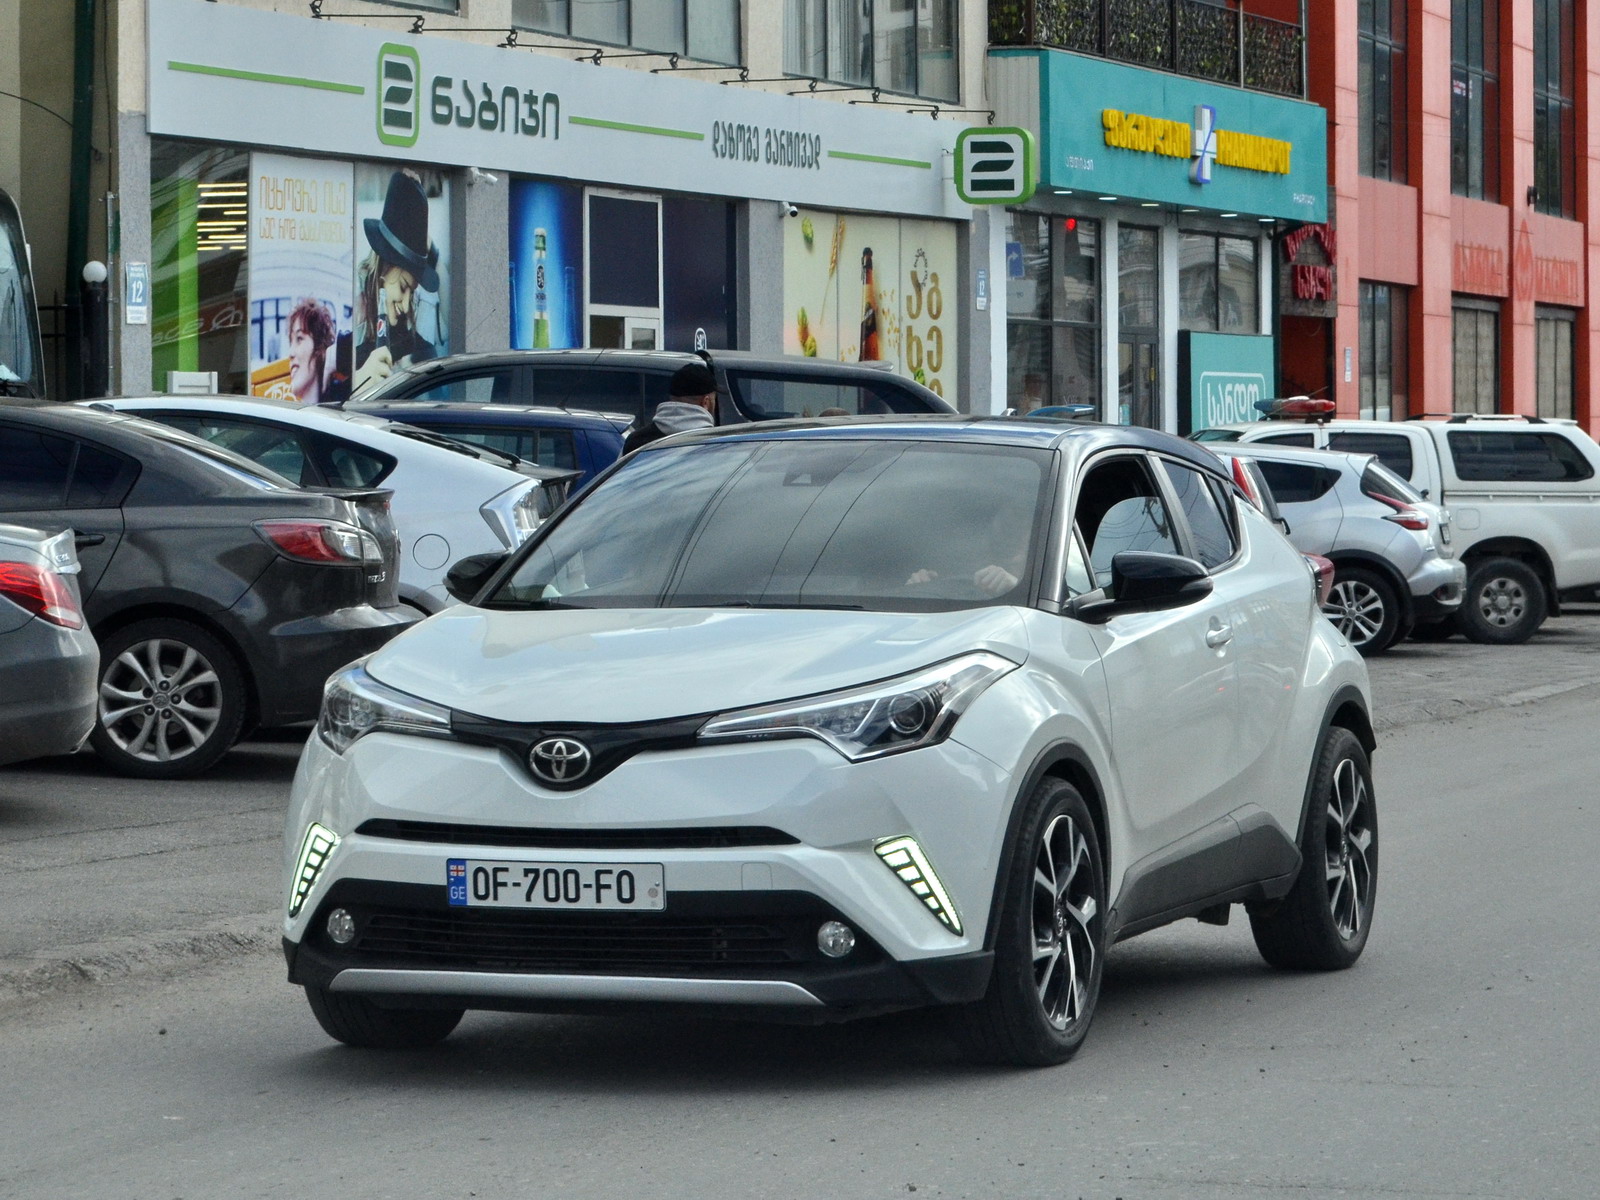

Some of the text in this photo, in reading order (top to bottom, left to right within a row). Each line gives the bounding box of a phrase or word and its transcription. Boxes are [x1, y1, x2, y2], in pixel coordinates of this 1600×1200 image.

[431, 76, 560, 140] ნაბიჯი
[712, 120, 821, 171] დაზოგე მარტივად
[132, 280, 143, 303] 12
[450, 886, 466, 900] GE
[472, 866, 635, 904] OF-700-FO
